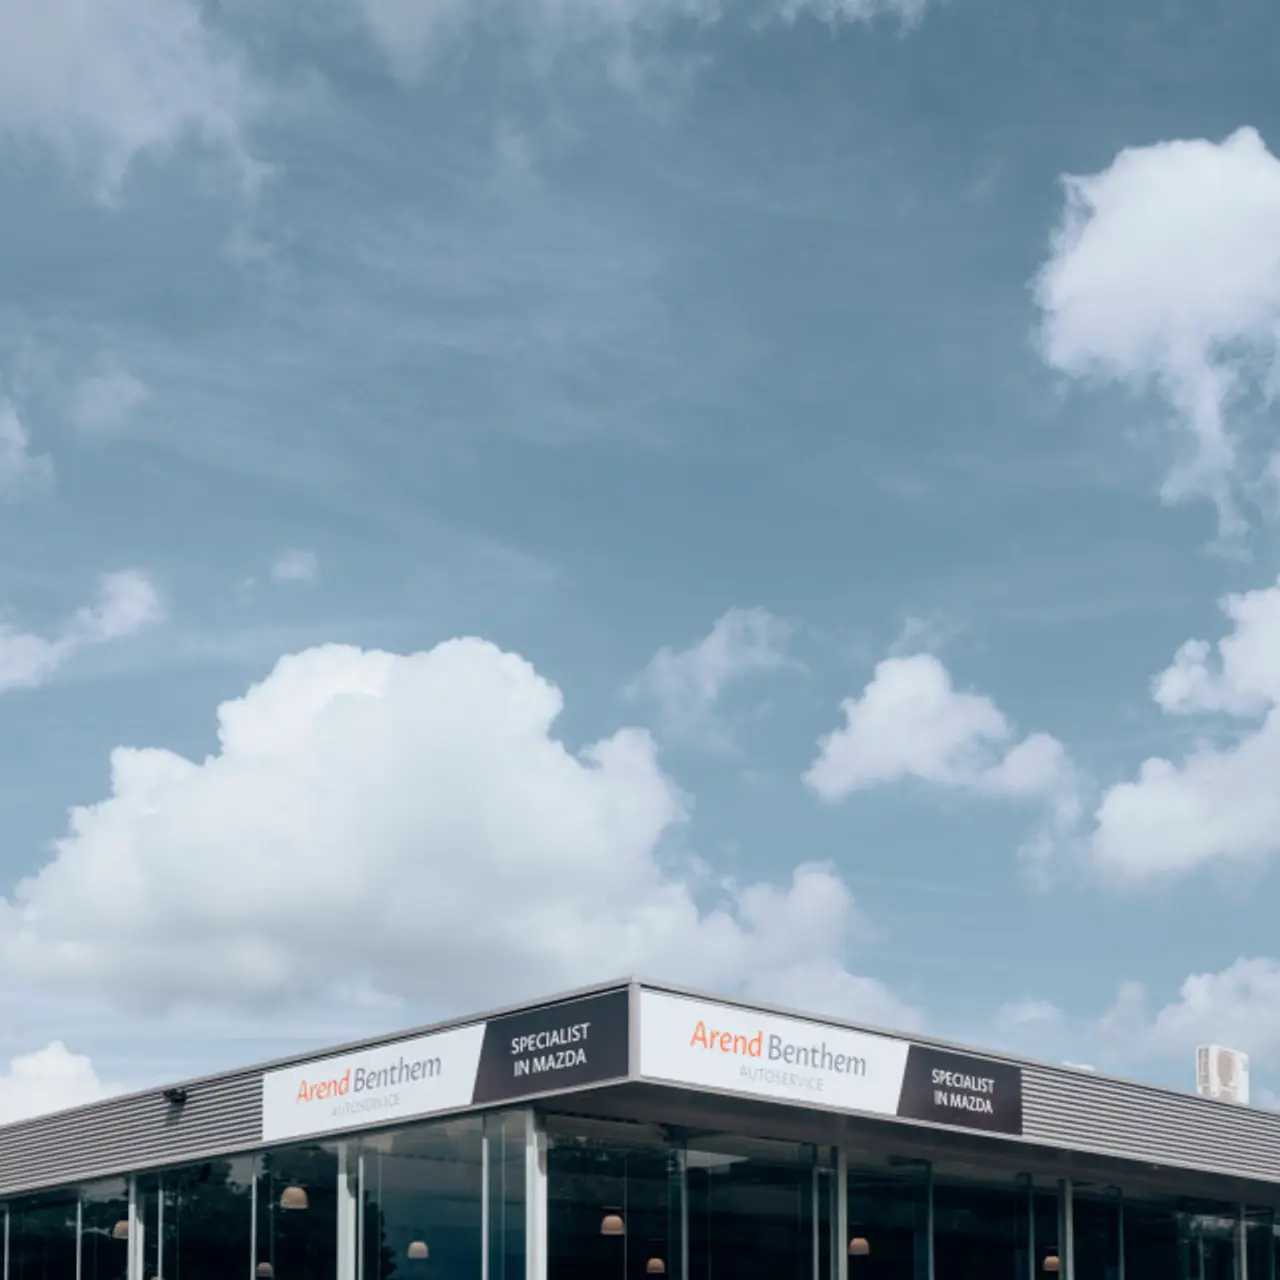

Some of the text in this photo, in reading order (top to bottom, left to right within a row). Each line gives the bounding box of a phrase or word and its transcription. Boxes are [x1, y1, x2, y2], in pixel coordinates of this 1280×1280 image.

[511, 1022, 591, 1055] SPECIALIST
[690, 1020, 867, 1077] Arend Benthem
[514, 1048, 587, 1077] IN MAZDA
[296, 1056, 442, 1104] Arend Benthem
[740, 1065, 824, 1091] AUTOSERVICE
[932, 1068, 995, 1093] SPECIALIST
[331, 1093, 401, 1116] AUTOSERVICE
[933, 1090, 994, 1114] IN MAZDA
